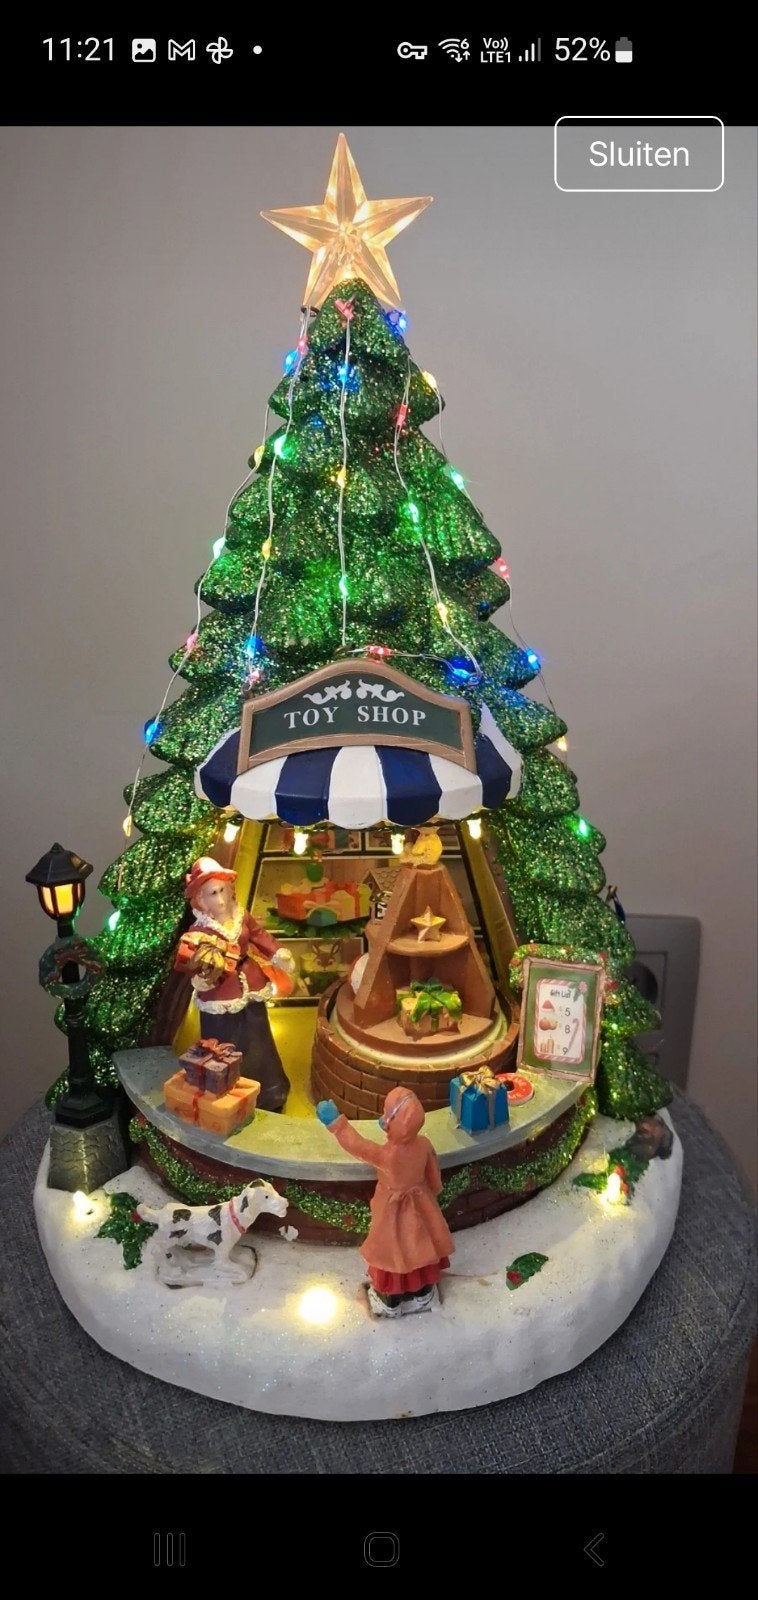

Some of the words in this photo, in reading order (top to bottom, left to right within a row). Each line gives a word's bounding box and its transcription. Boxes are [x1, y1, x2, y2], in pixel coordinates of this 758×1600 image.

[283, 706, 338, 729] TOY
[357, 705, 426, 726] SHOP
[564, 1008, 571, 1017] 5
[564, 1025, 571, 1034] 8
[562, 1047, 569, 1056] 9
